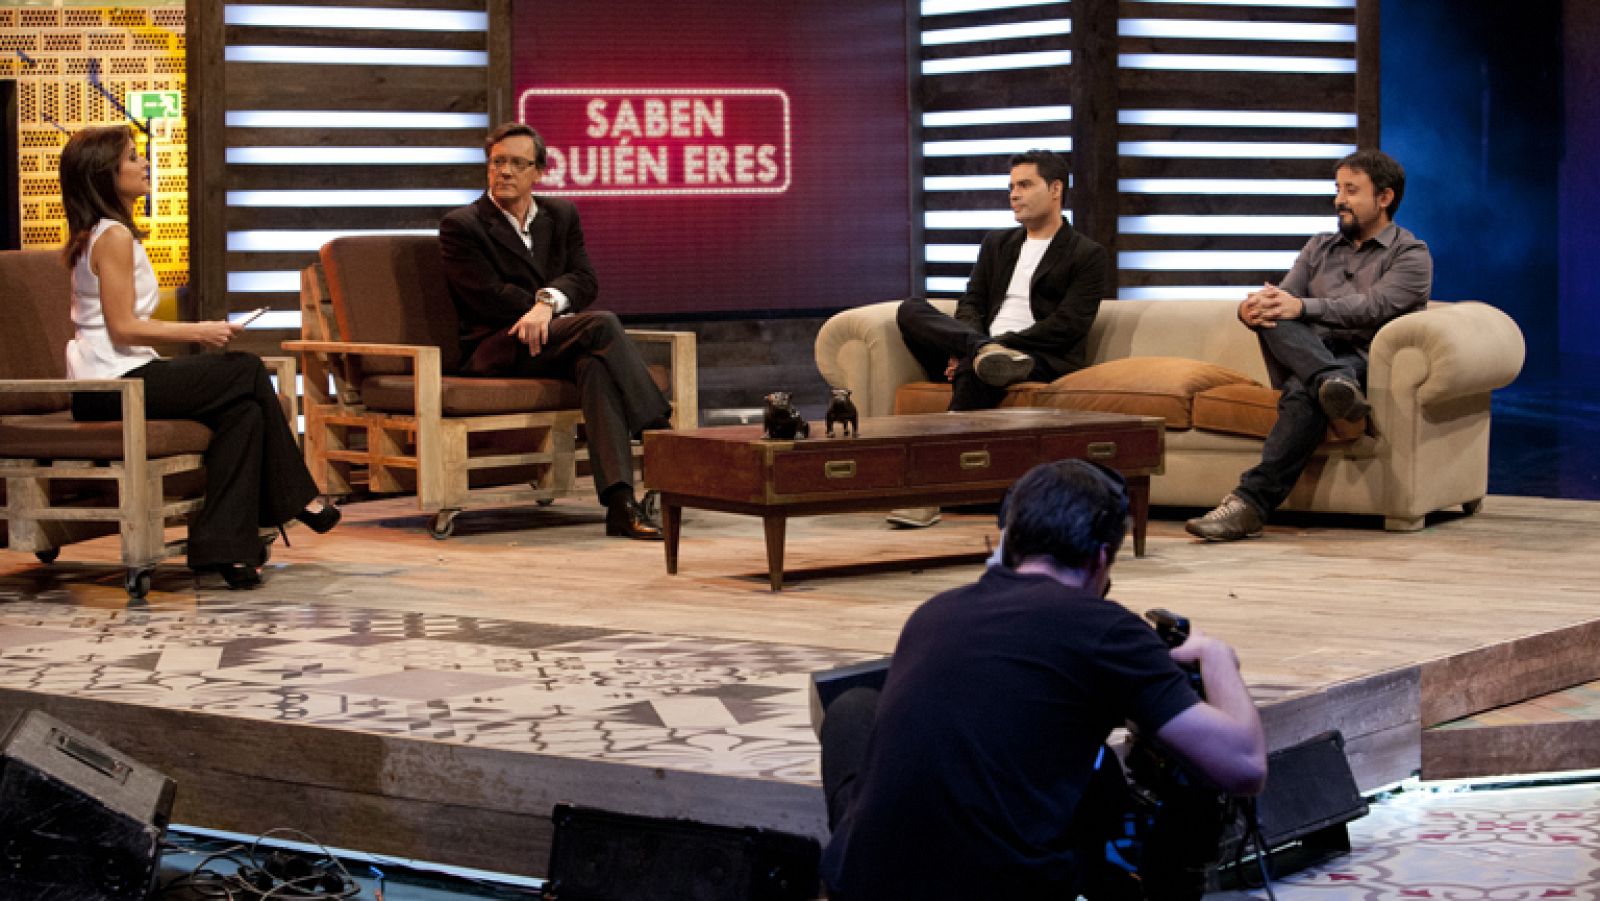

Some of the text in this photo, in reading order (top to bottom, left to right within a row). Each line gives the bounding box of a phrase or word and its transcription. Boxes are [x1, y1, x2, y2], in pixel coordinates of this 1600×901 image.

[586, 98, 724, 138] SABEN
[540, 136, 778, 188] QUIÉN ERES
